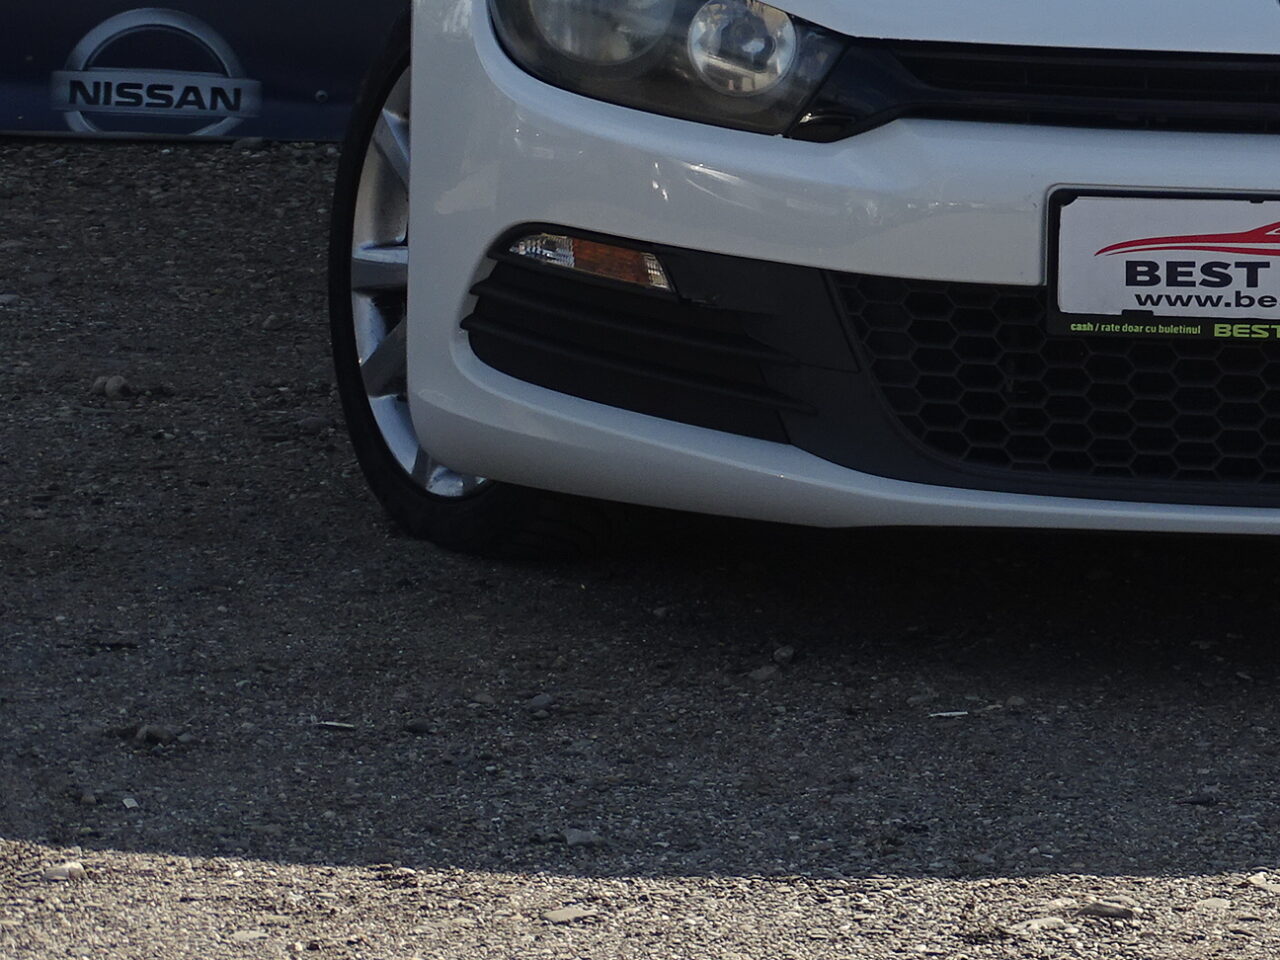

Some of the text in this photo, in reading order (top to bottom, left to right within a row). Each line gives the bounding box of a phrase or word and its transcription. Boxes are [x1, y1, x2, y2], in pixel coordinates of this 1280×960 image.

[68, 79, 243, 112] NISSAN
[1125, 260, 1271, 288] BEST
[1070, 322, 1094, 332] cash
[1101, 324, 1120, 332] rate
[1121, 323, 1143, 333] doar
[1145, 326, 1156, 334] cu
[1158, 324, 1201, 335] buletinul
